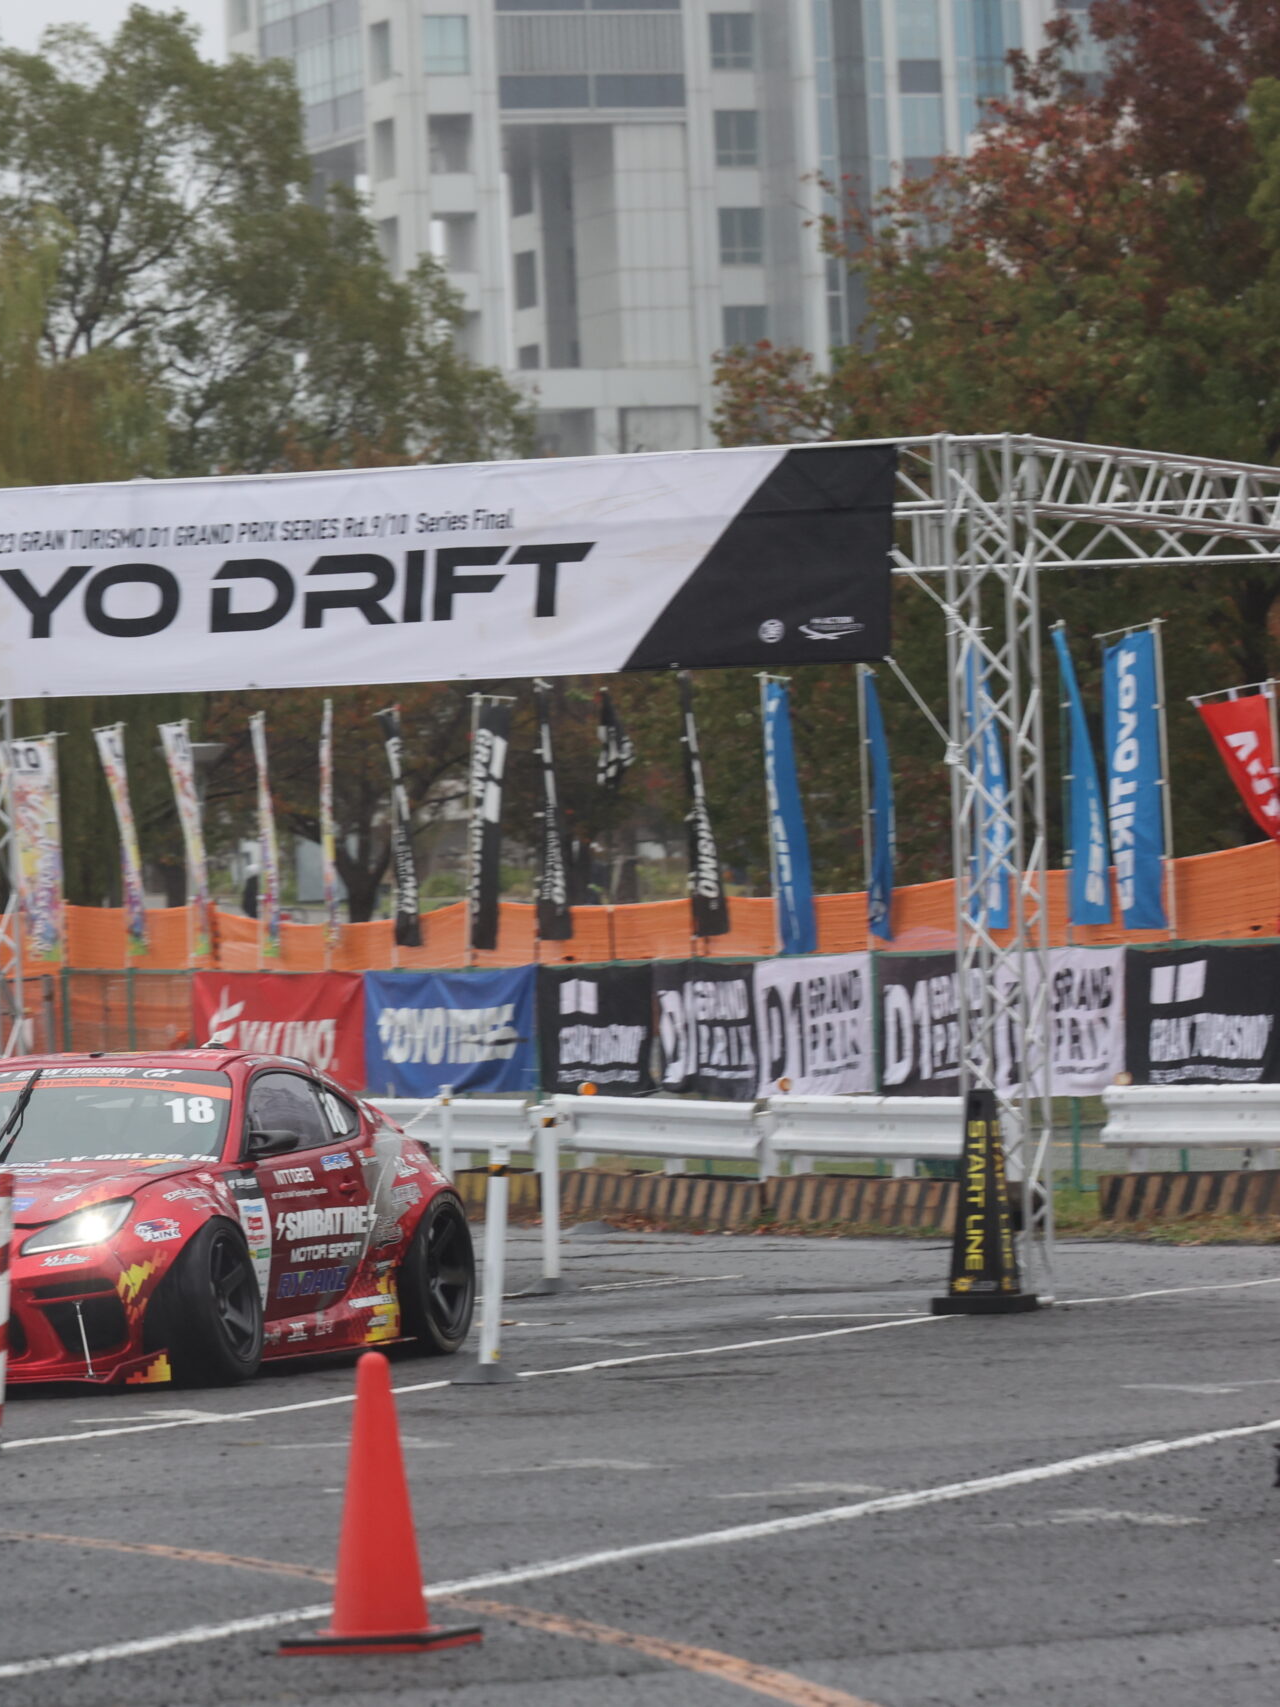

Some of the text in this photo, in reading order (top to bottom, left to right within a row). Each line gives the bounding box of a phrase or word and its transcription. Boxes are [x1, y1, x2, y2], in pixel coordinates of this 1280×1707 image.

[20, 530, 66, 553] GRAN
[68, 527, 146, 551] TURISMO
[173, 523, 233, 547] GRAND
[236, 520, 278, 544] PRIX
[280, 517, 340, 542] SERIES
[415, 510, 468, 534] Series
[471, 507, 515, 530] Final
[208, 541, 599, 635] DRIFT
[883, 980, 933, 1086] D1
[164, 1096, 216, 1124] 18
[964, 1119, 987, 1271] START LINE
